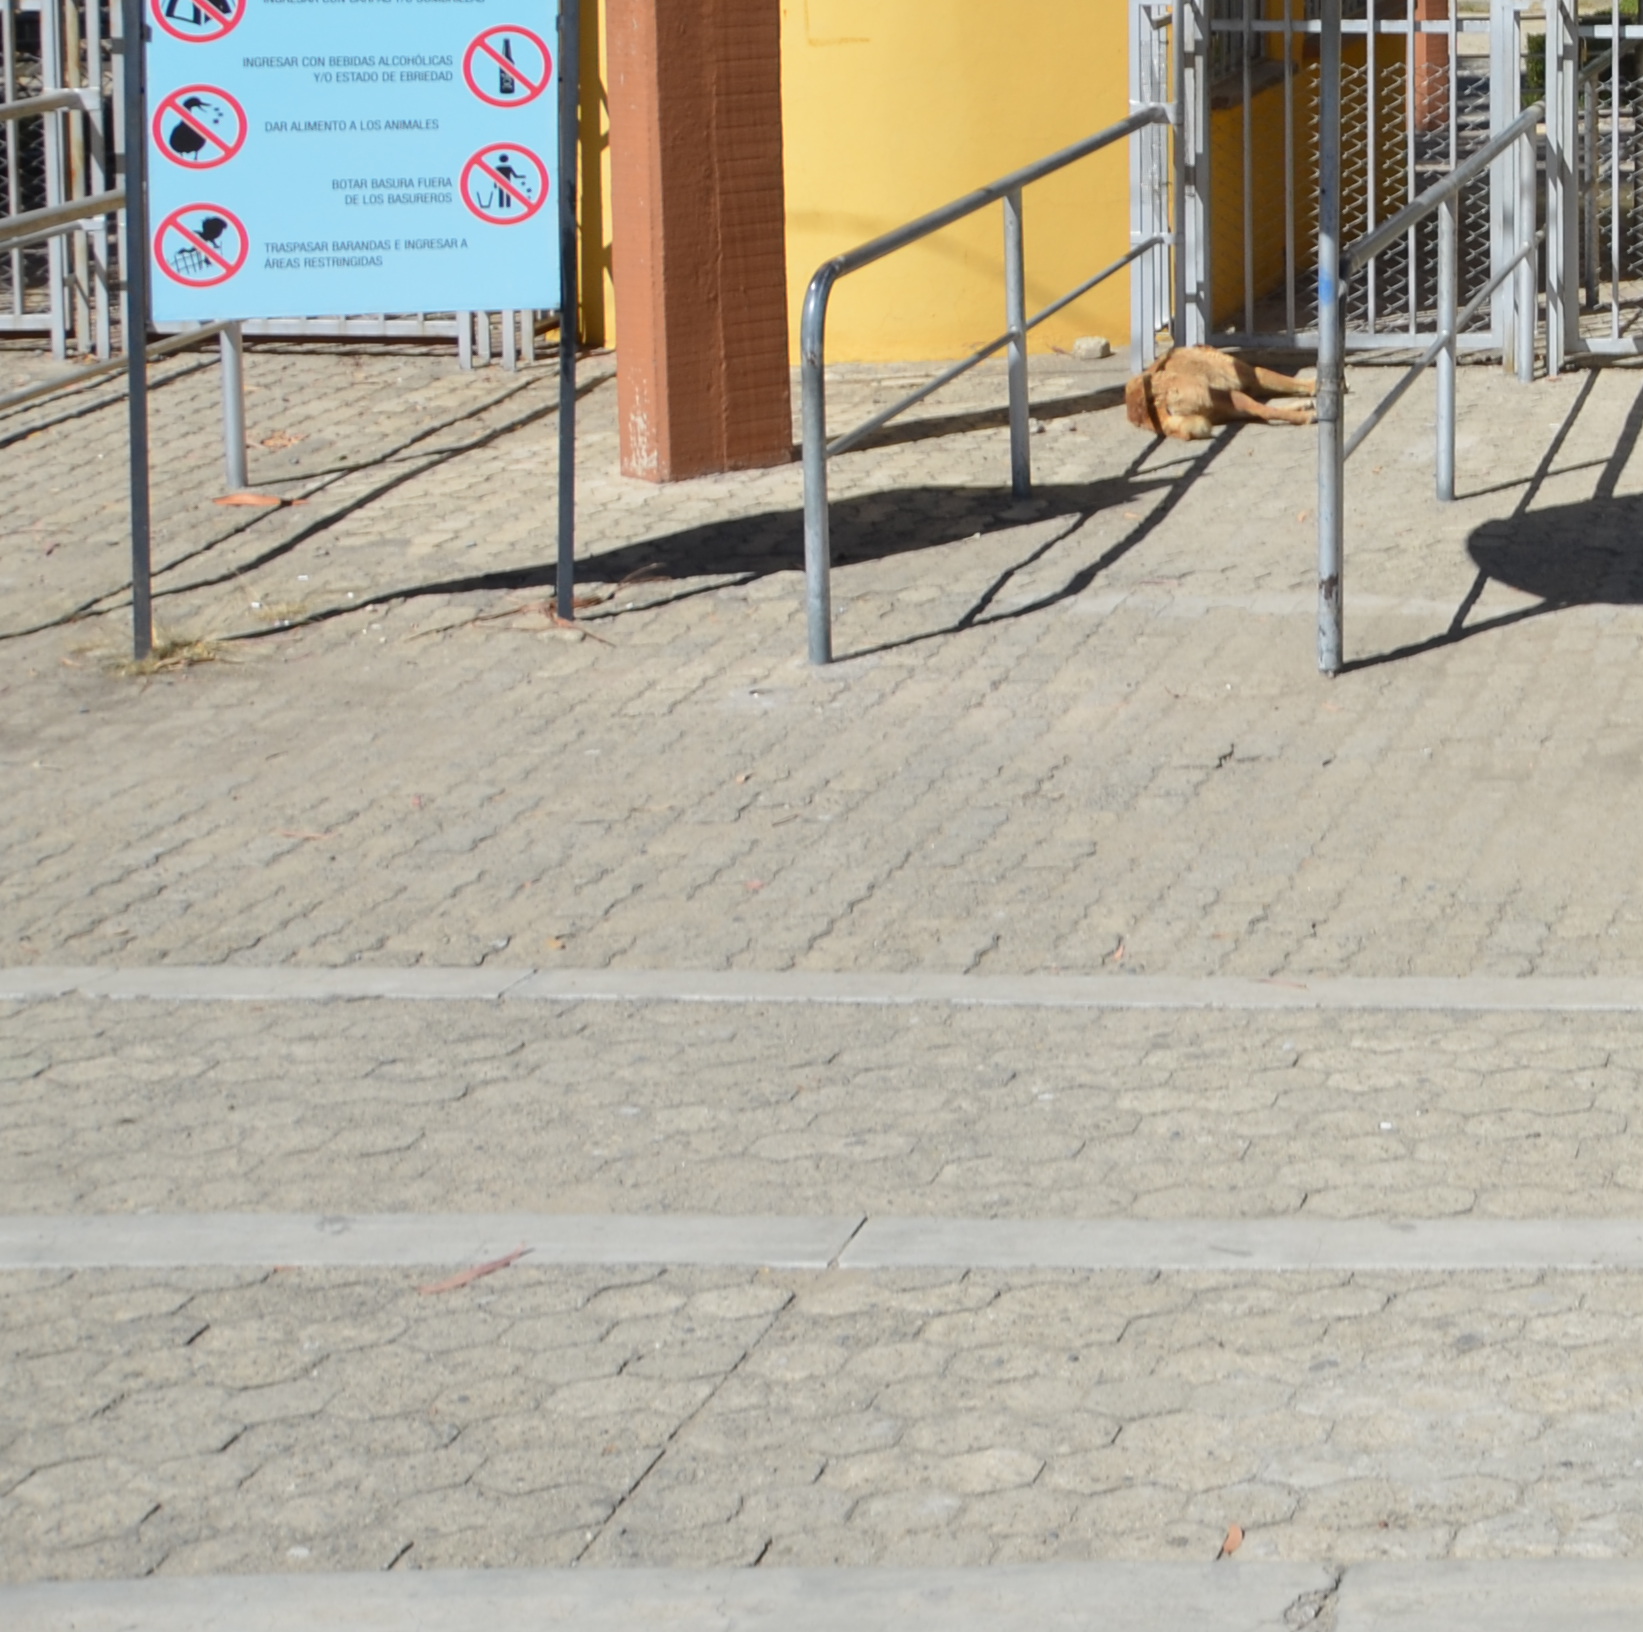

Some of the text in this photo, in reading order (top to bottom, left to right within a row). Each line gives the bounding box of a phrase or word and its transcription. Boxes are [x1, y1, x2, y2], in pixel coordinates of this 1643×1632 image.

[242, 56, 299, 68] INGRESAR
[301, 56, 326, 67] CON
[328, 55, 376, 67] BEBIDAS
[335, 71, 378, 83] ESTADO
[381, 70, 396, 83] DE
[399, 70, 453, 82] EBRIEDAD
[264, 121, 288, 132] DAR
[290, 120, 347, 132] ALIMENTO
[359, 119, 381, 131] LOS
[384, 119, 439, 131] ANIMALES
[331, 176, 452, 190] BOTAR BASURA FUERA
[344, 192, 452, 206] DE LOS BASUREROS
[265, 241, 329, 253] TRASPASAR
[331, 239, 391, 252] BARANDAS
[404, 238, 458, 250] INGRESAR
[303, 255, 383, 268] RESTRINGIDAS
